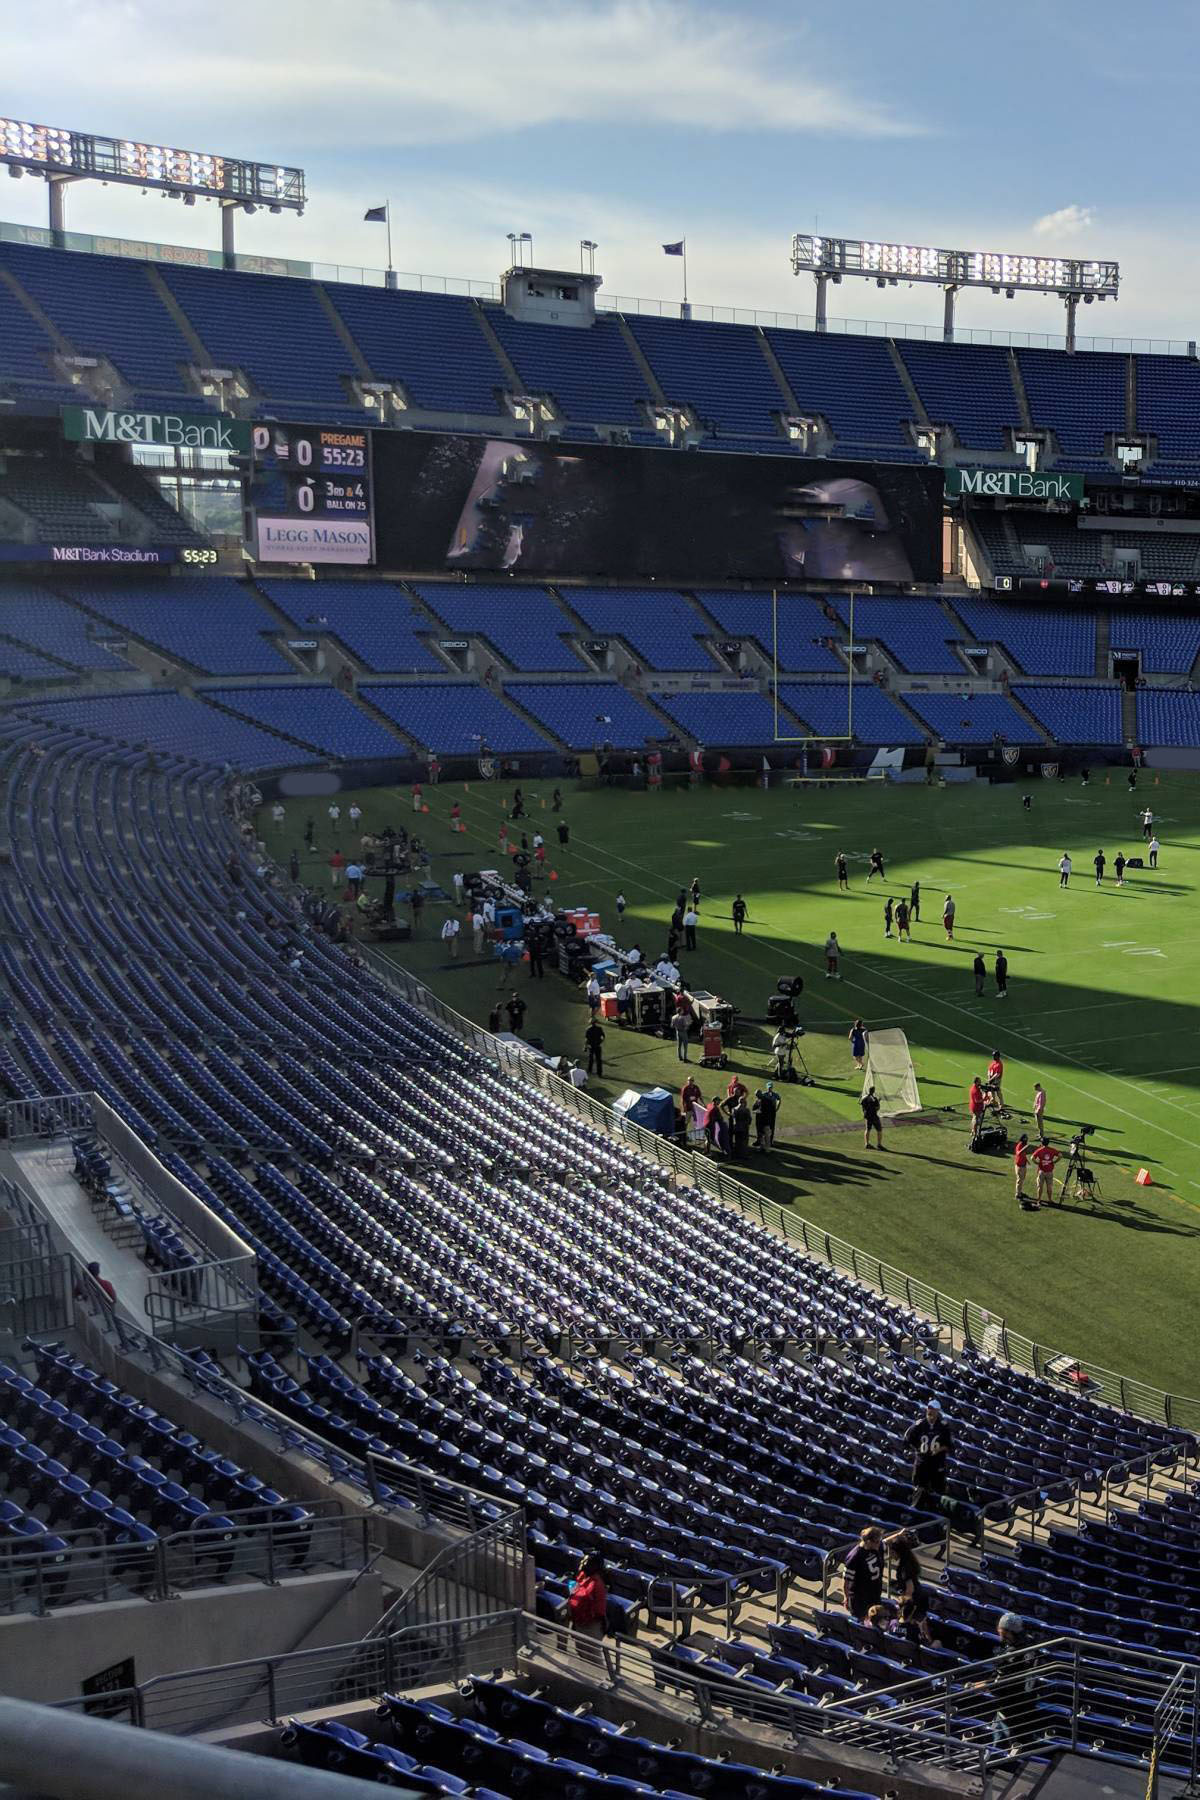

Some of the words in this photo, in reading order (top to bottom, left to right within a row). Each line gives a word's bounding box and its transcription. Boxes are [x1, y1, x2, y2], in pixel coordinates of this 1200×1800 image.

[83, 410, 161, 443] M&T
[164, 416, 233, 448] Bank
[320, 432, 365, 447] PREGAME
[297, 440, 312, 466] 0
[323, 448, 364, 467] 55:23
[355, 483, 364, 497] 4
[960, 470, 1017, 495] M&T
[1019, 473, 1071, 498] Bank
[298, 486, 314, 512] 0
[326, 500, 344, 510] BALL
[346, 501, 355, 510] ON
[357, 501, 366, 510] 25
[266, 527, 308, 543] LEGG
[313, 528, 368, 544] MASON
[53, 547, 82, 561] M&T
[83, 548, 111, 561] Bank
[111, 549, 159, 562] Stadium
[183, 550, 217, 563] 55:23
